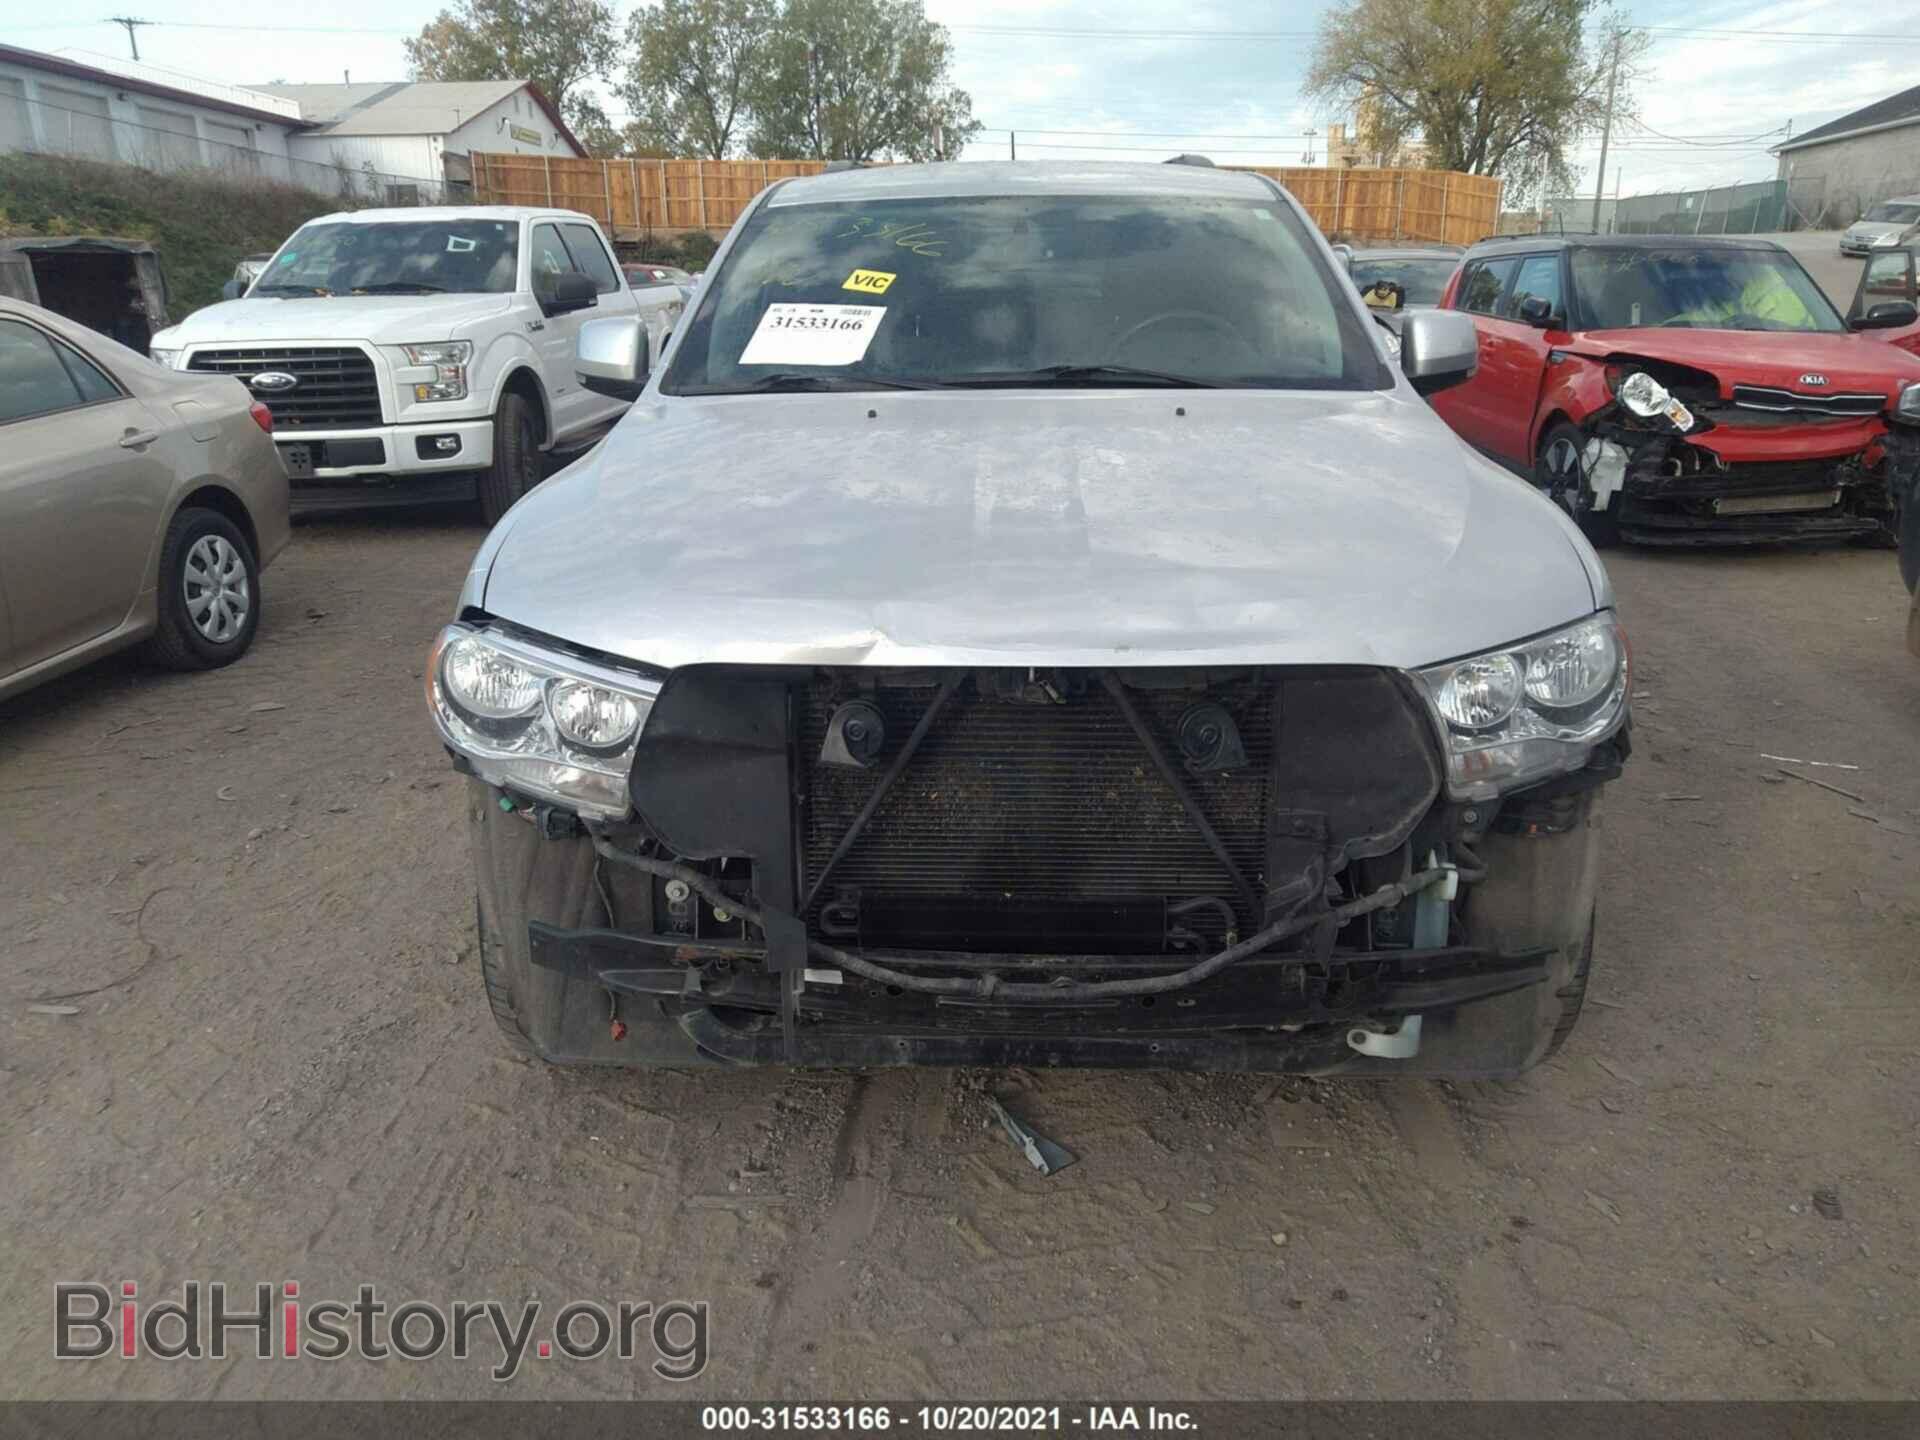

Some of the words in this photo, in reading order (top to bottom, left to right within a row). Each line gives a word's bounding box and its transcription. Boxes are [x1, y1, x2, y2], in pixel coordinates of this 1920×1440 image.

[853, 274, 889, 289] VIC
[770, 315, 863, 331] 31533166
[1804, 374, 1826, 385] KIA
